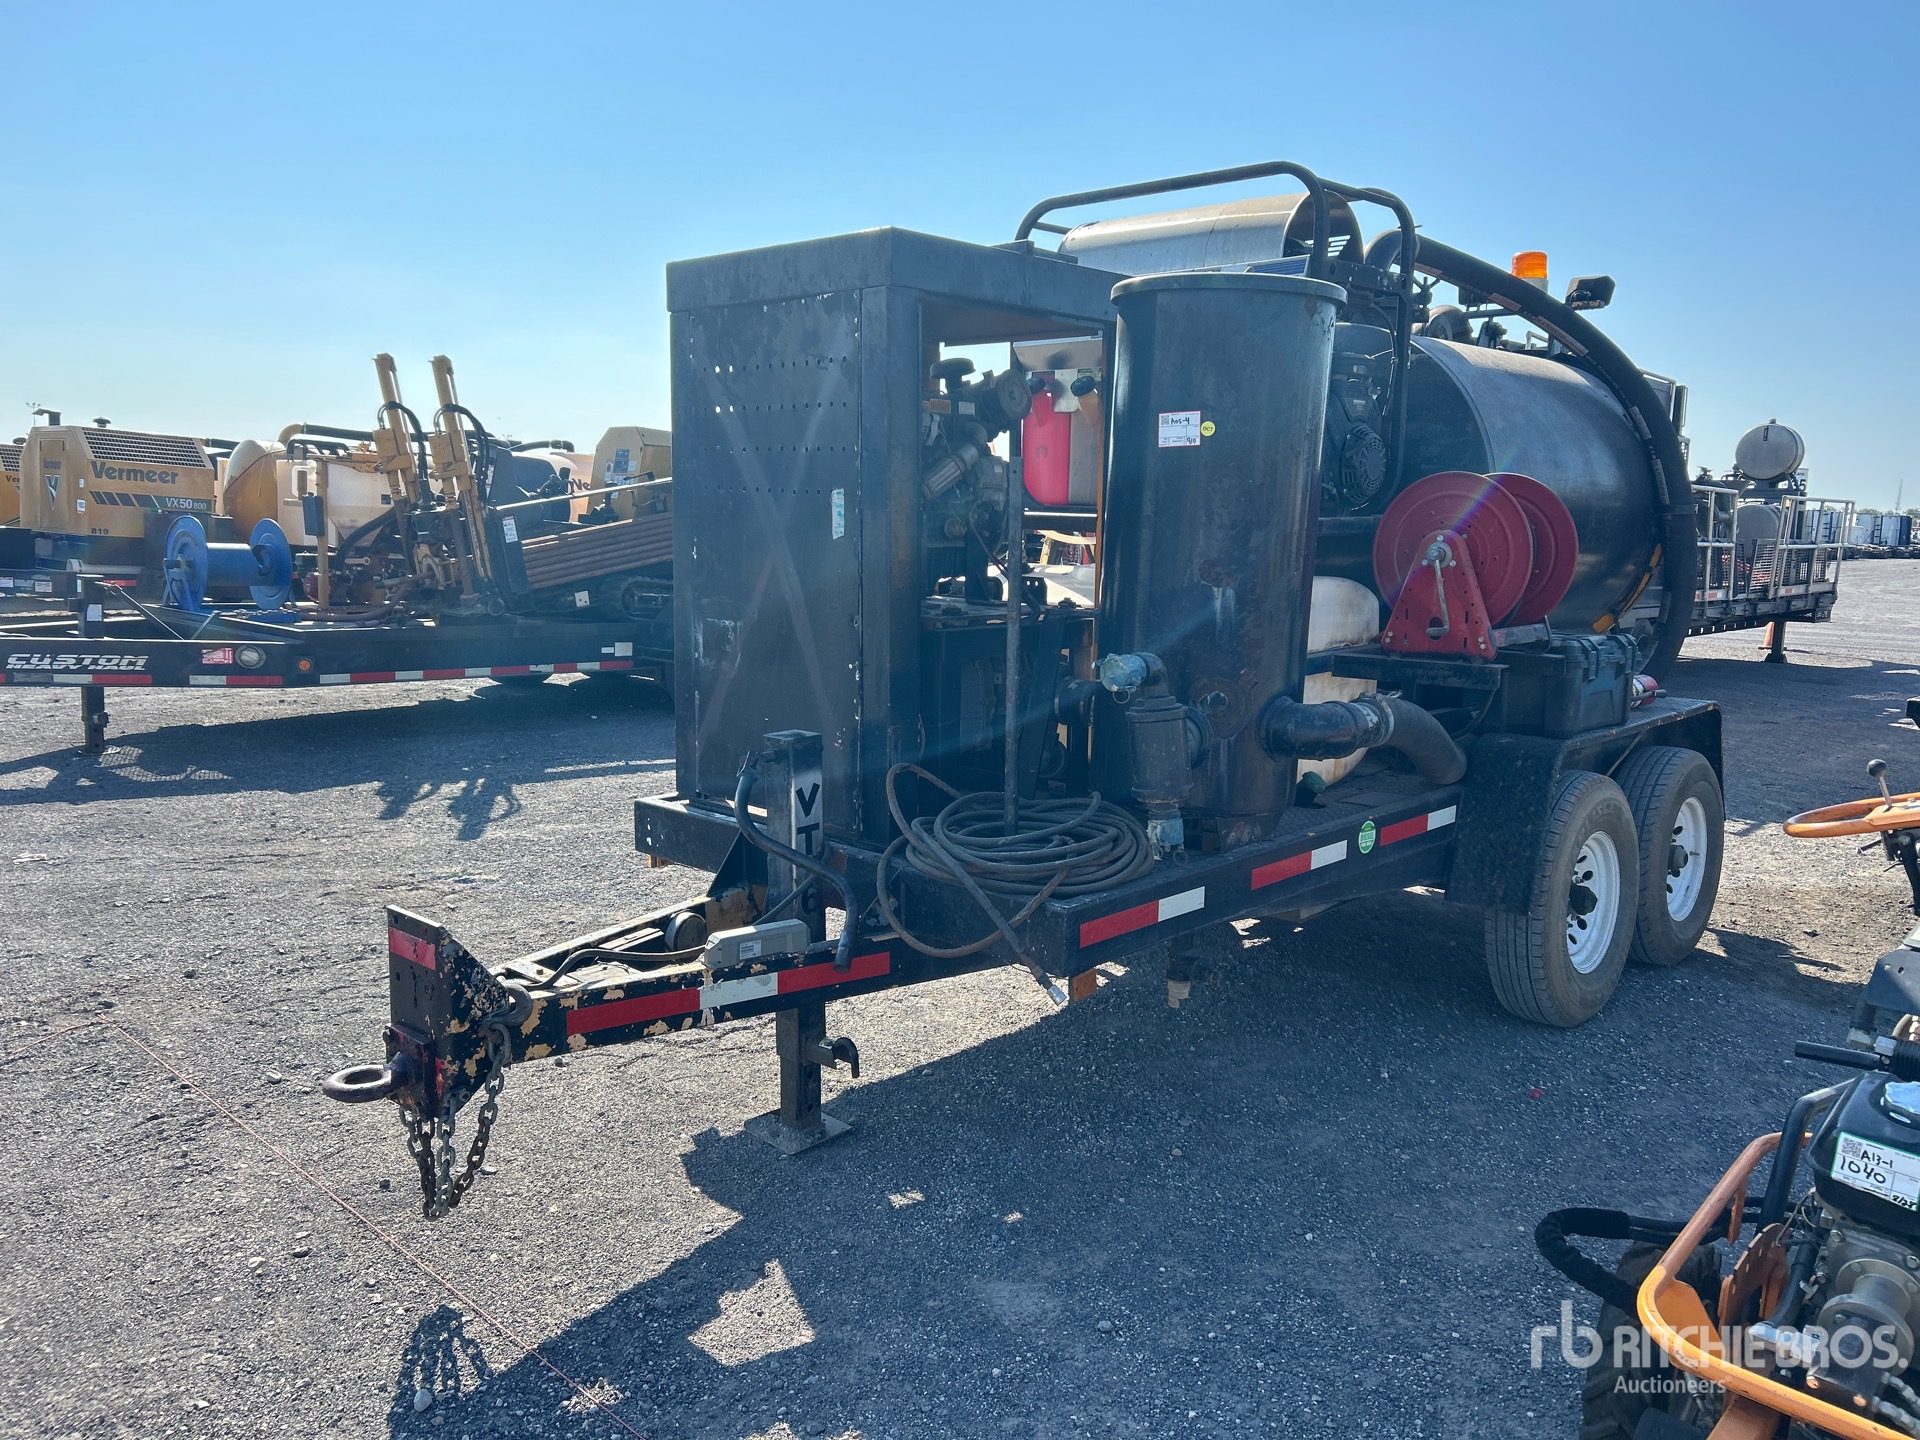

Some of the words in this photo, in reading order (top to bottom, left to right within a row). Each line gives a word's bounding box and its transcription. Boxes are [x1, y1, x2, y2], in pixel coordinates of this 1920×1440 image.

[91, 461, 179, 485] Vermeer
[91, 527, 109, 535] 819
[7, 653, 149, 666] CUSTOM
[1840, 1156, 1886, 1184] 1040
